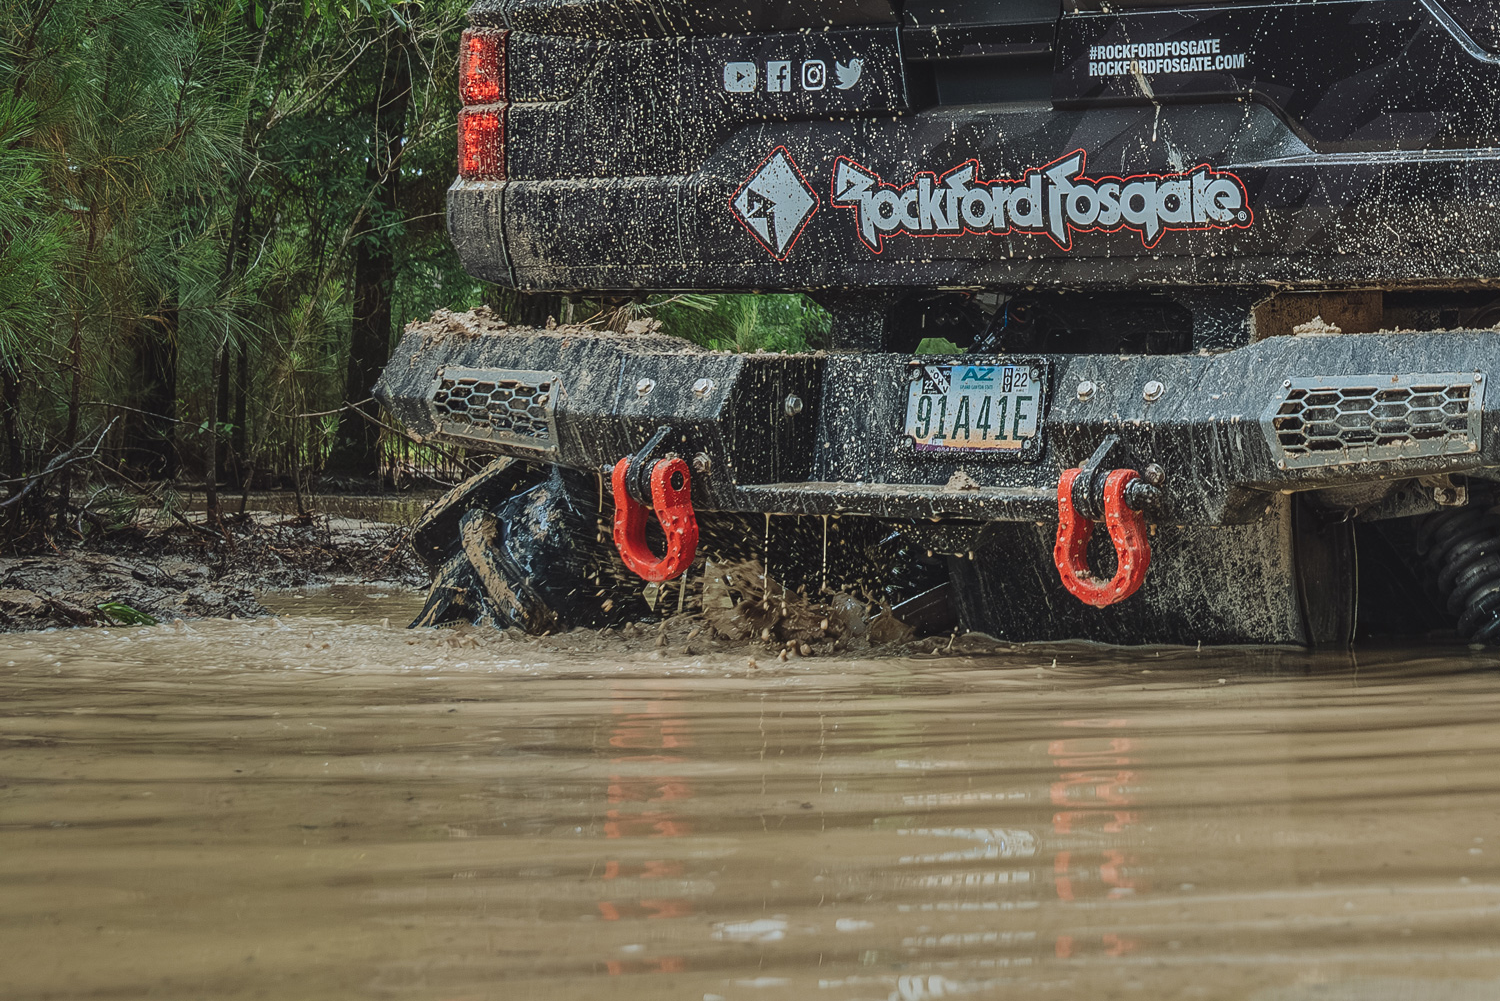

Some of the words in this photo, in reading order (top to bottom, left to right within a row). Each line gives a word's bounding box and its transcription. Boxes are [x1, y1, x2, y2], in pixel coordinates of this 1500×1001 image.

[1089, 39, 1221, 60] #ROCKFORDFOSGATE
[1089, 54, 1245, 76] ROCKFORDFOSGATE.COM
[836, 160, 1044, 248] Rockford
[961, 367, 995, 381] AZ
[1003, 368, 1013, 392] NOV
[1014, 372, 1028, 388] 22
[915, 395, 1033, 440] 91A41E
